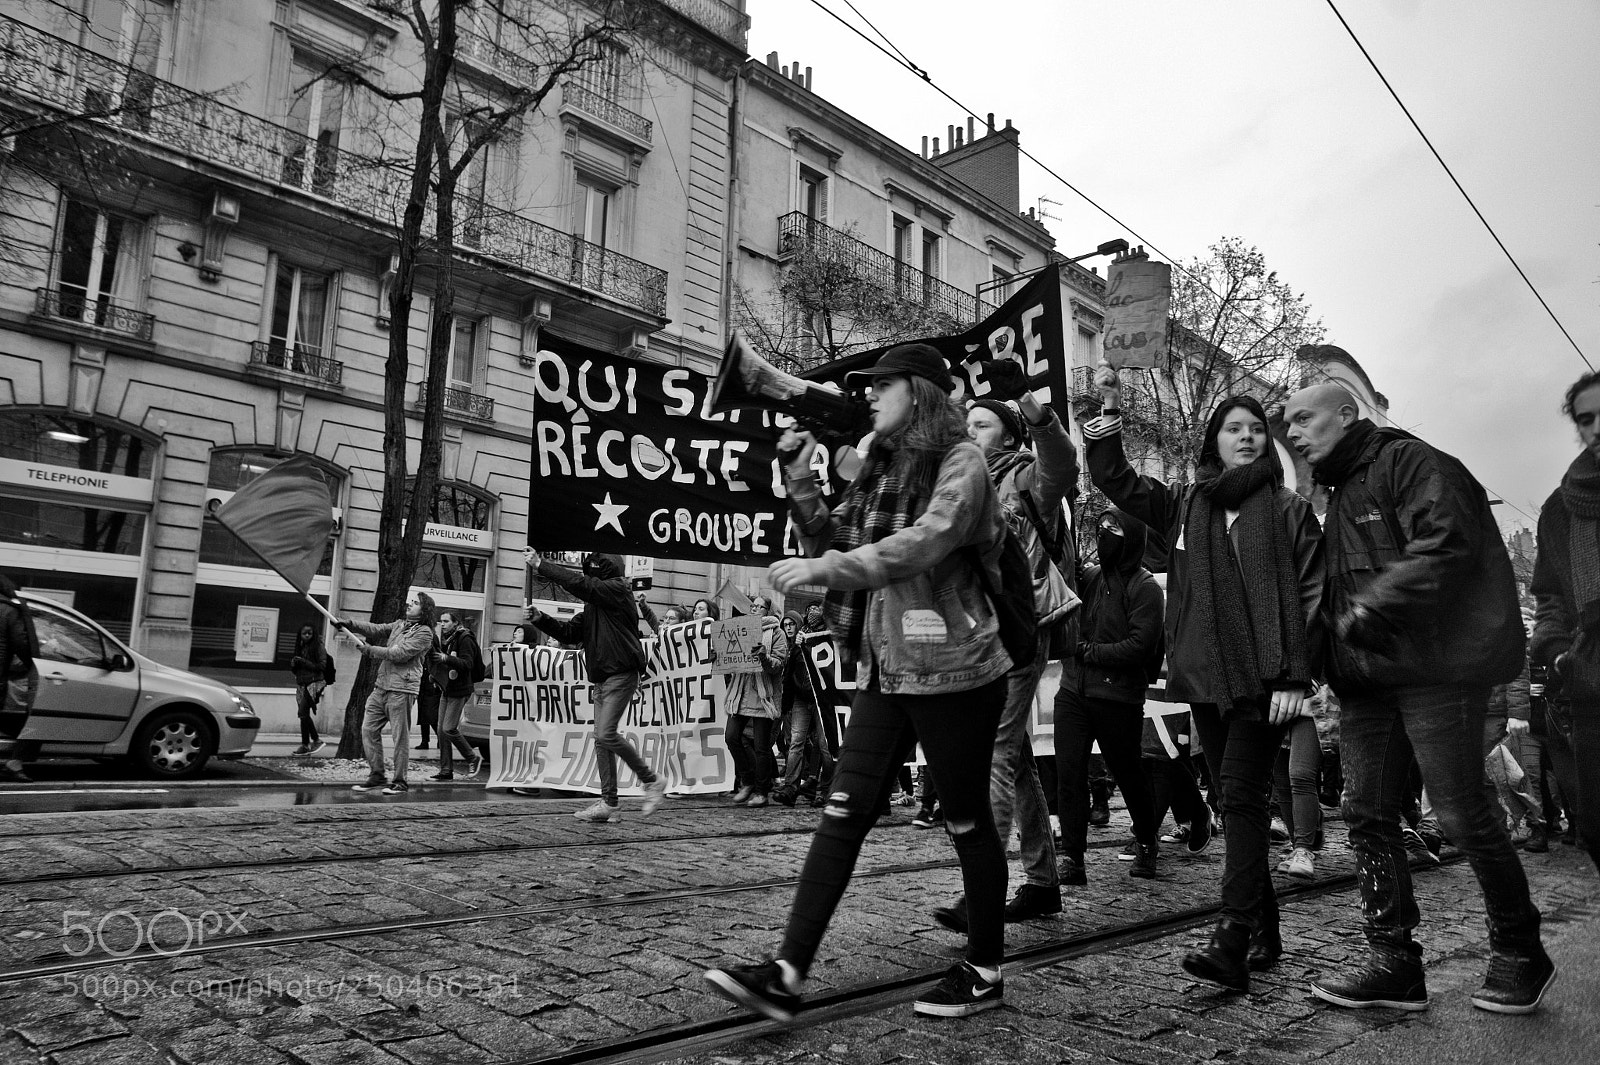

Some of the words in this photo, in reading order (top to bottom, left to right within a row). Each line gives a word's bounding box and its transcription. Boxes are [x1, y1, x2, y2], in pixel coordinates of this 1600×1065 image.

[535, 350, 637, 413] QUI
[536, 407, 750, 492] RÉCOLTE
[27, 468, 110, 489] TELEPHONIE
[423, 527, 479, 543] URVEILLANCE
[648, 508, 775, 554] GROUPE
[718, 623, 748, 640] Avis
